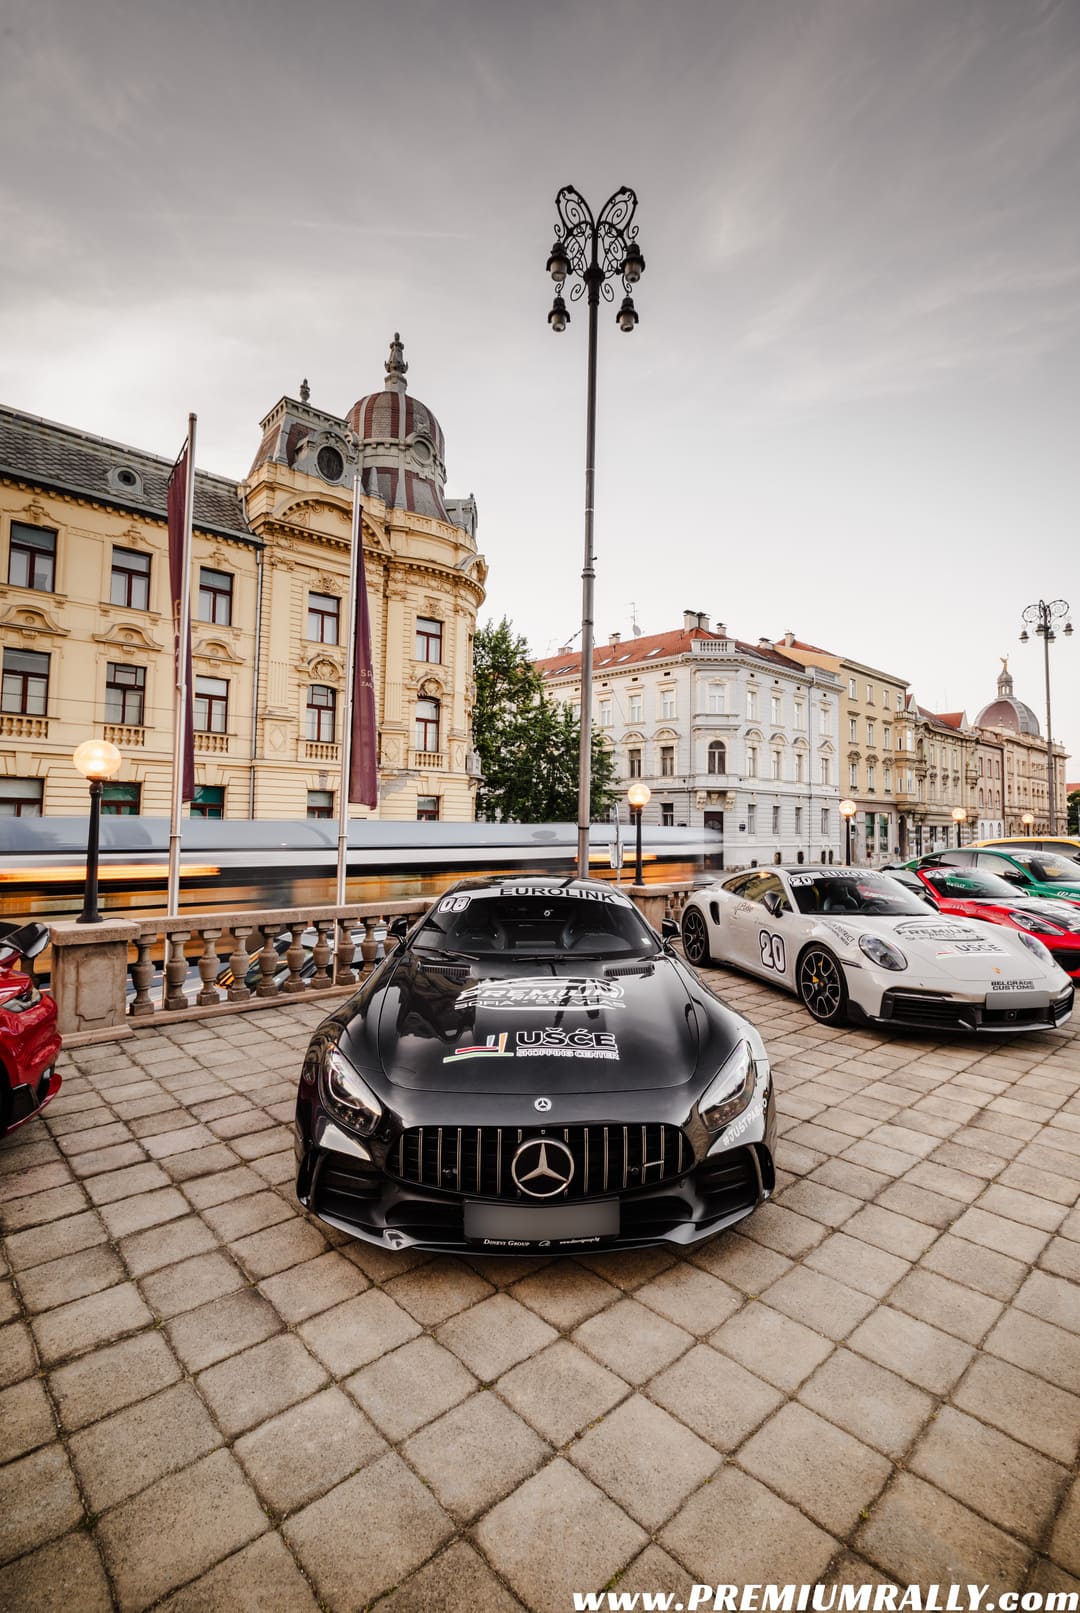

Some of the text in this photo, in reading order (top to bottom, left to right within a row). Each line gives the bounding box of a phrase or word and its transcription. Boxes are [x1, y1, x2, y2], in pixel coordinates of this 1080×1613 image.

[787, 876, 814, 888] 20
[500, 887, 616, 903] EUROLINK
[759, 928, 786, 974] 20
[456, 987, 620, 1001] PREMIUM
[454, 1000, 515, 1010] SOFIA
[569, 1000, 626, 1008] VLAS
[516, 1027, 617, 1048] UŠĆE
[516, 1048, 574, 1057] SHOPPING
[574, 1050, 620, 1060] CENTER
